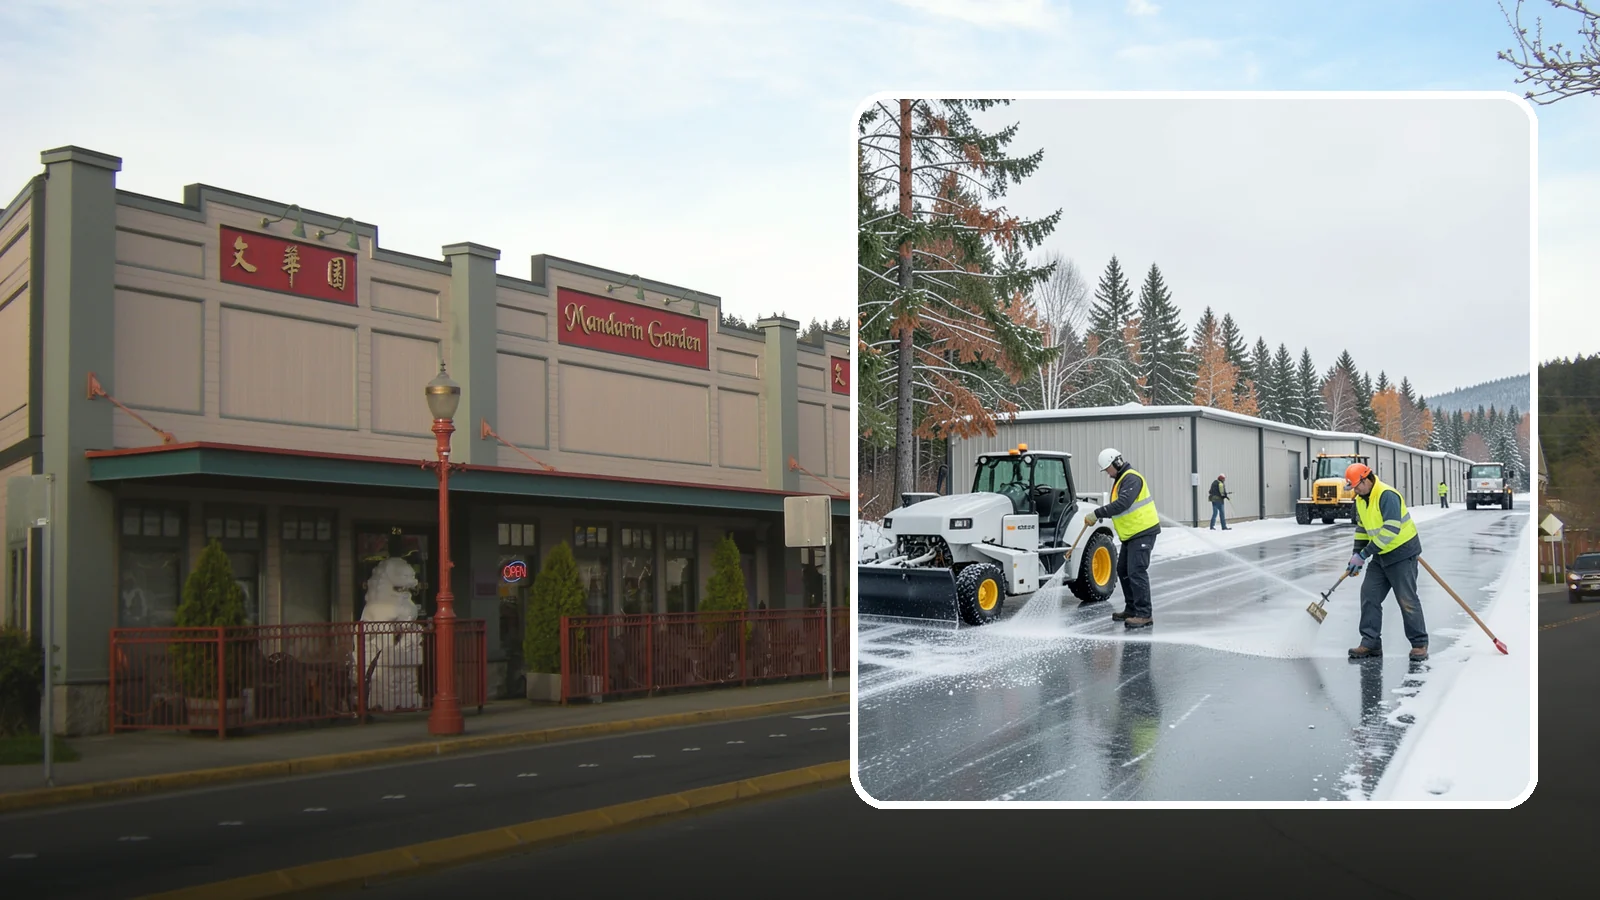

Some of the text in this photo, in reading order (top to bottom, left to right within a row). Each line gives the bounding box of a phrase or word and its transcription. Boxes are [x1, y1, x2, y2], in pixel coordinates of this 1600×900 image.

[231, 236, 346, 291] 文華園
[564, 302, 701, 352] Mandarin Garden
[503, 565, 527, 578] OPEN
